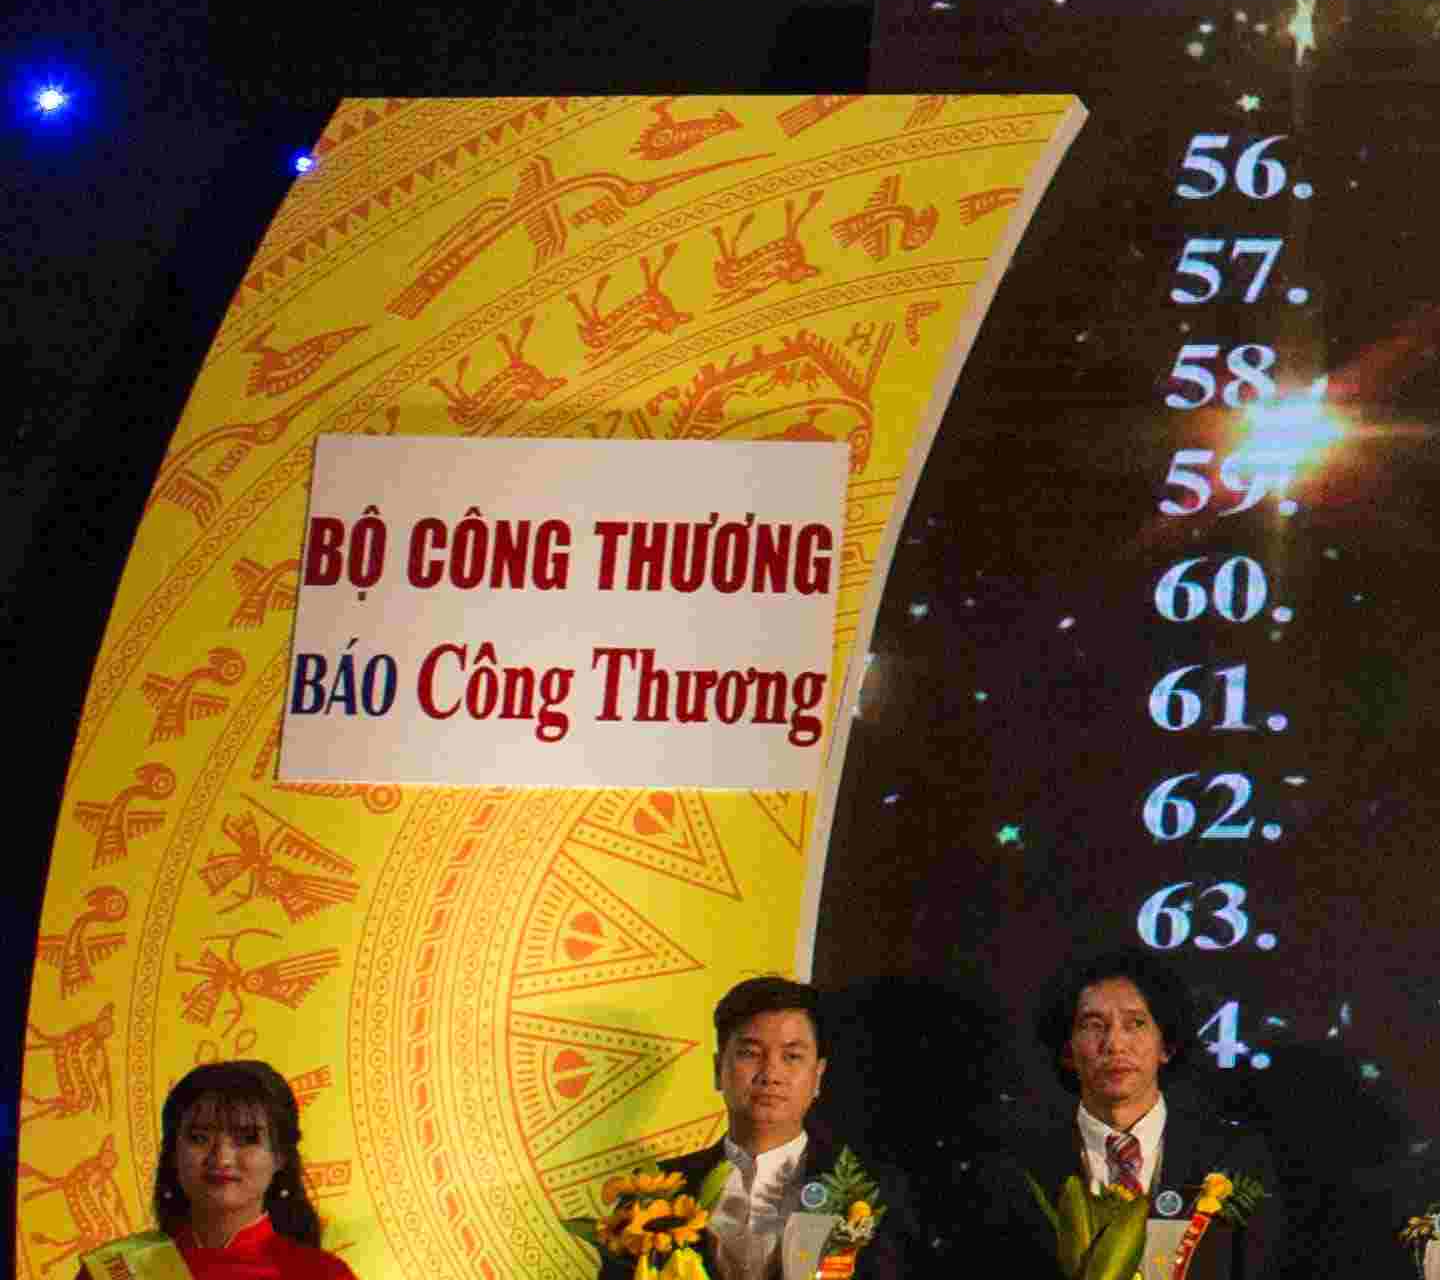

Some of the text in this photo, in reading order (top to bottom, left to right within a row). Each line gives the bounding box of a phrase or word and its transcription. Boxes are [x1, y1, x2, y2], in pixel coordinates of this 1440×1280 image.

[1175, 133, 1313, 200] 56.
[1170, 237, 1309, 304] 57.
[303, 505, 833, 601] BỘ CÔNG THƯƠNG
[1152, 556, 1292, 623] 60.
[290, 637, 828, 748] BÁO Công Thương
[1148, 666, 1288, 732] 61.
[1143, 773, 1283, 840] 62.
[1137, 883, 1277, 950] 63.
[1198, 1000, 1271, 1070] 4.
